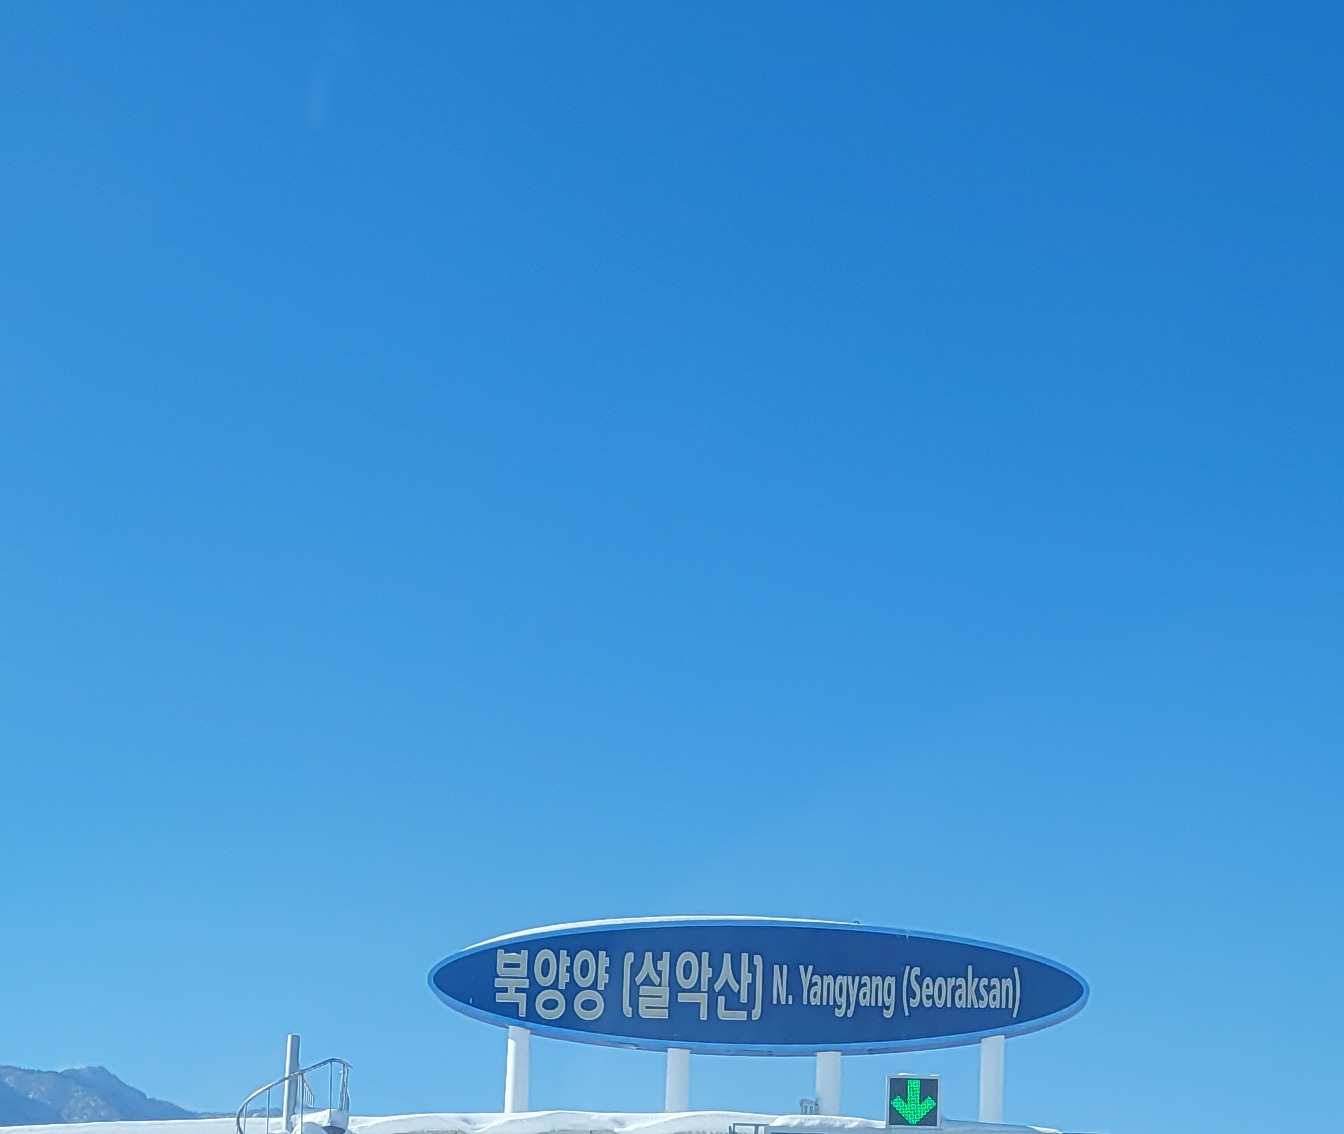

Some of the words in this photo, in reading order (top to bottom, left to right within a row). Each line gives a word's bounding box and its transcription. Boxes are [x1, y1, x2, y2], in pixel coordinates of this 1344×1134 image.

[494, 949, 610, 1020] 북양양
[772, 964, 793, 1005] N.
[799, 964, 896, 1018] Yangyang
[902, 964, 1021, 1018] (Seoraksan)
